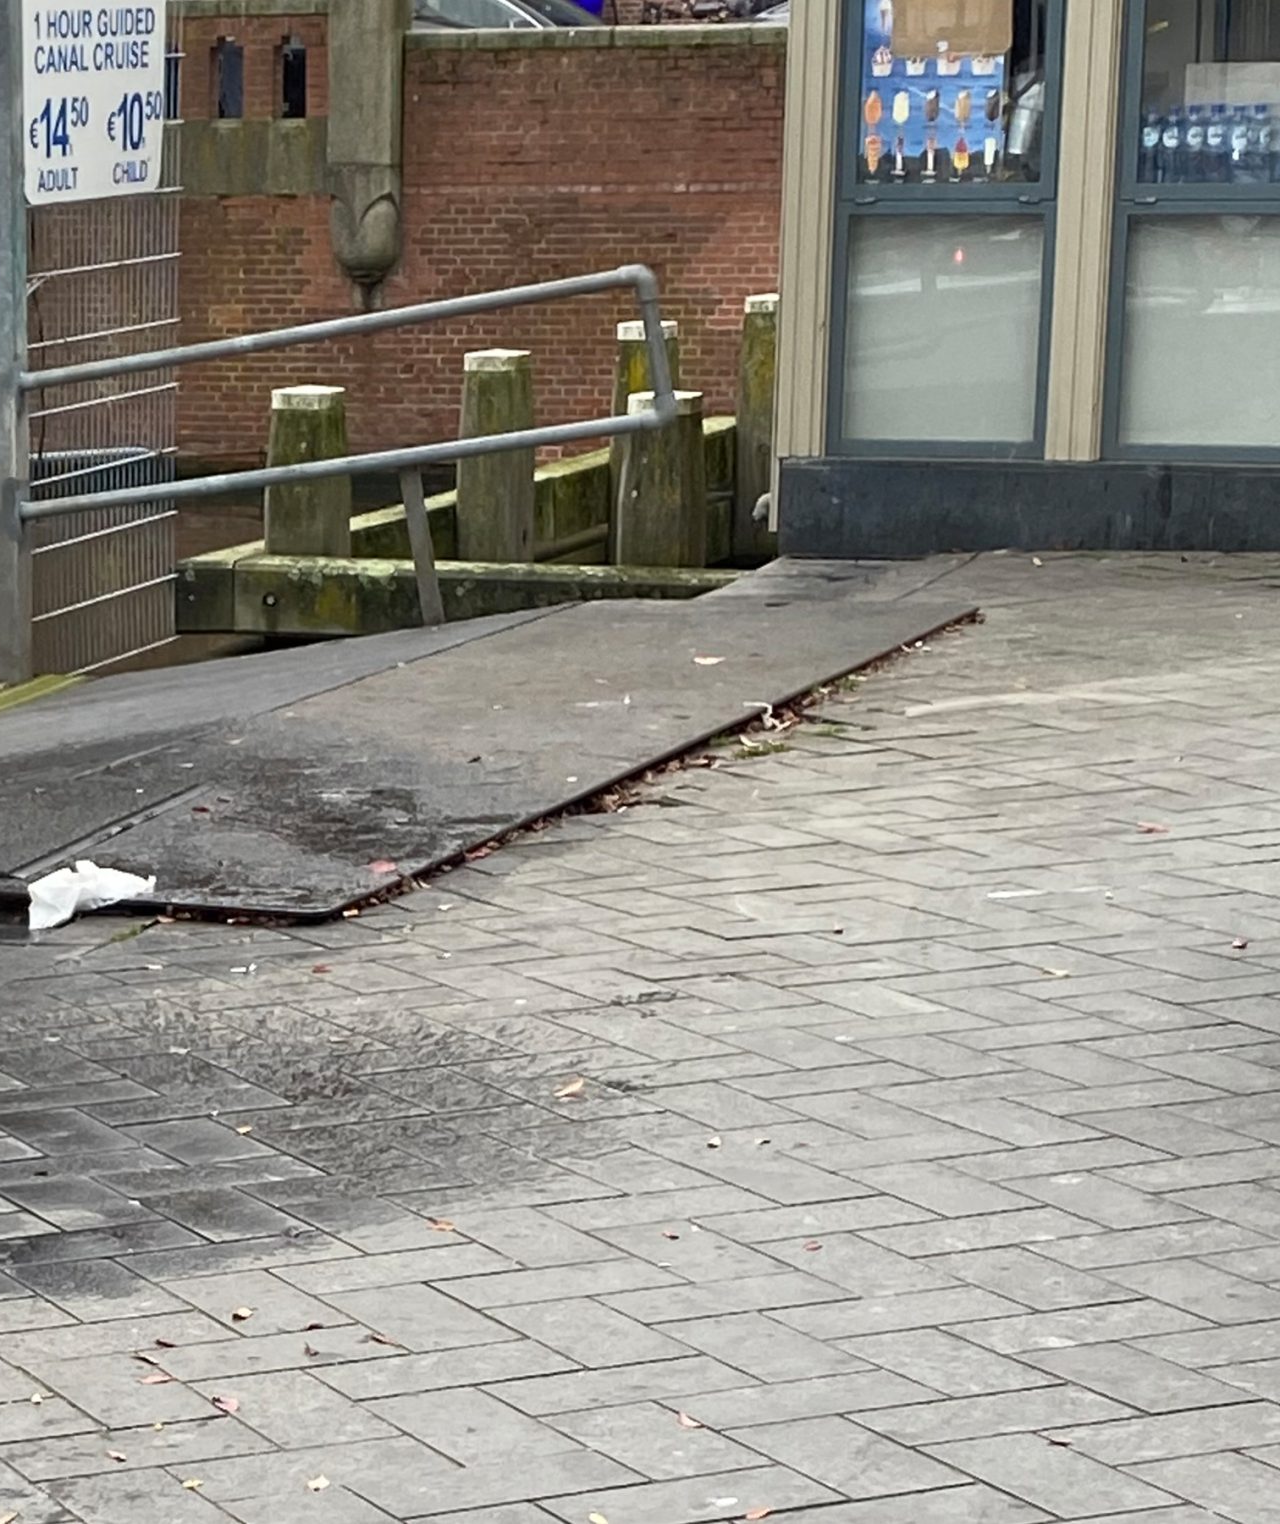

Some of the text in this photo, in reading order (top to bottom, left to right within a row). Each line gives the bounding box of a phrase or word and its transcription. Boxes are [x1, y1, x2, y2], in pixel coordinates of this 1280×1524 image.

[34, 8, 155, 39] 1 HOUR GUIDED
[34, 41, 149, 74] CANAL CRUISE
[37, 167, 78, 192] ADULT
[113, 160, 148, 184] CHILD
